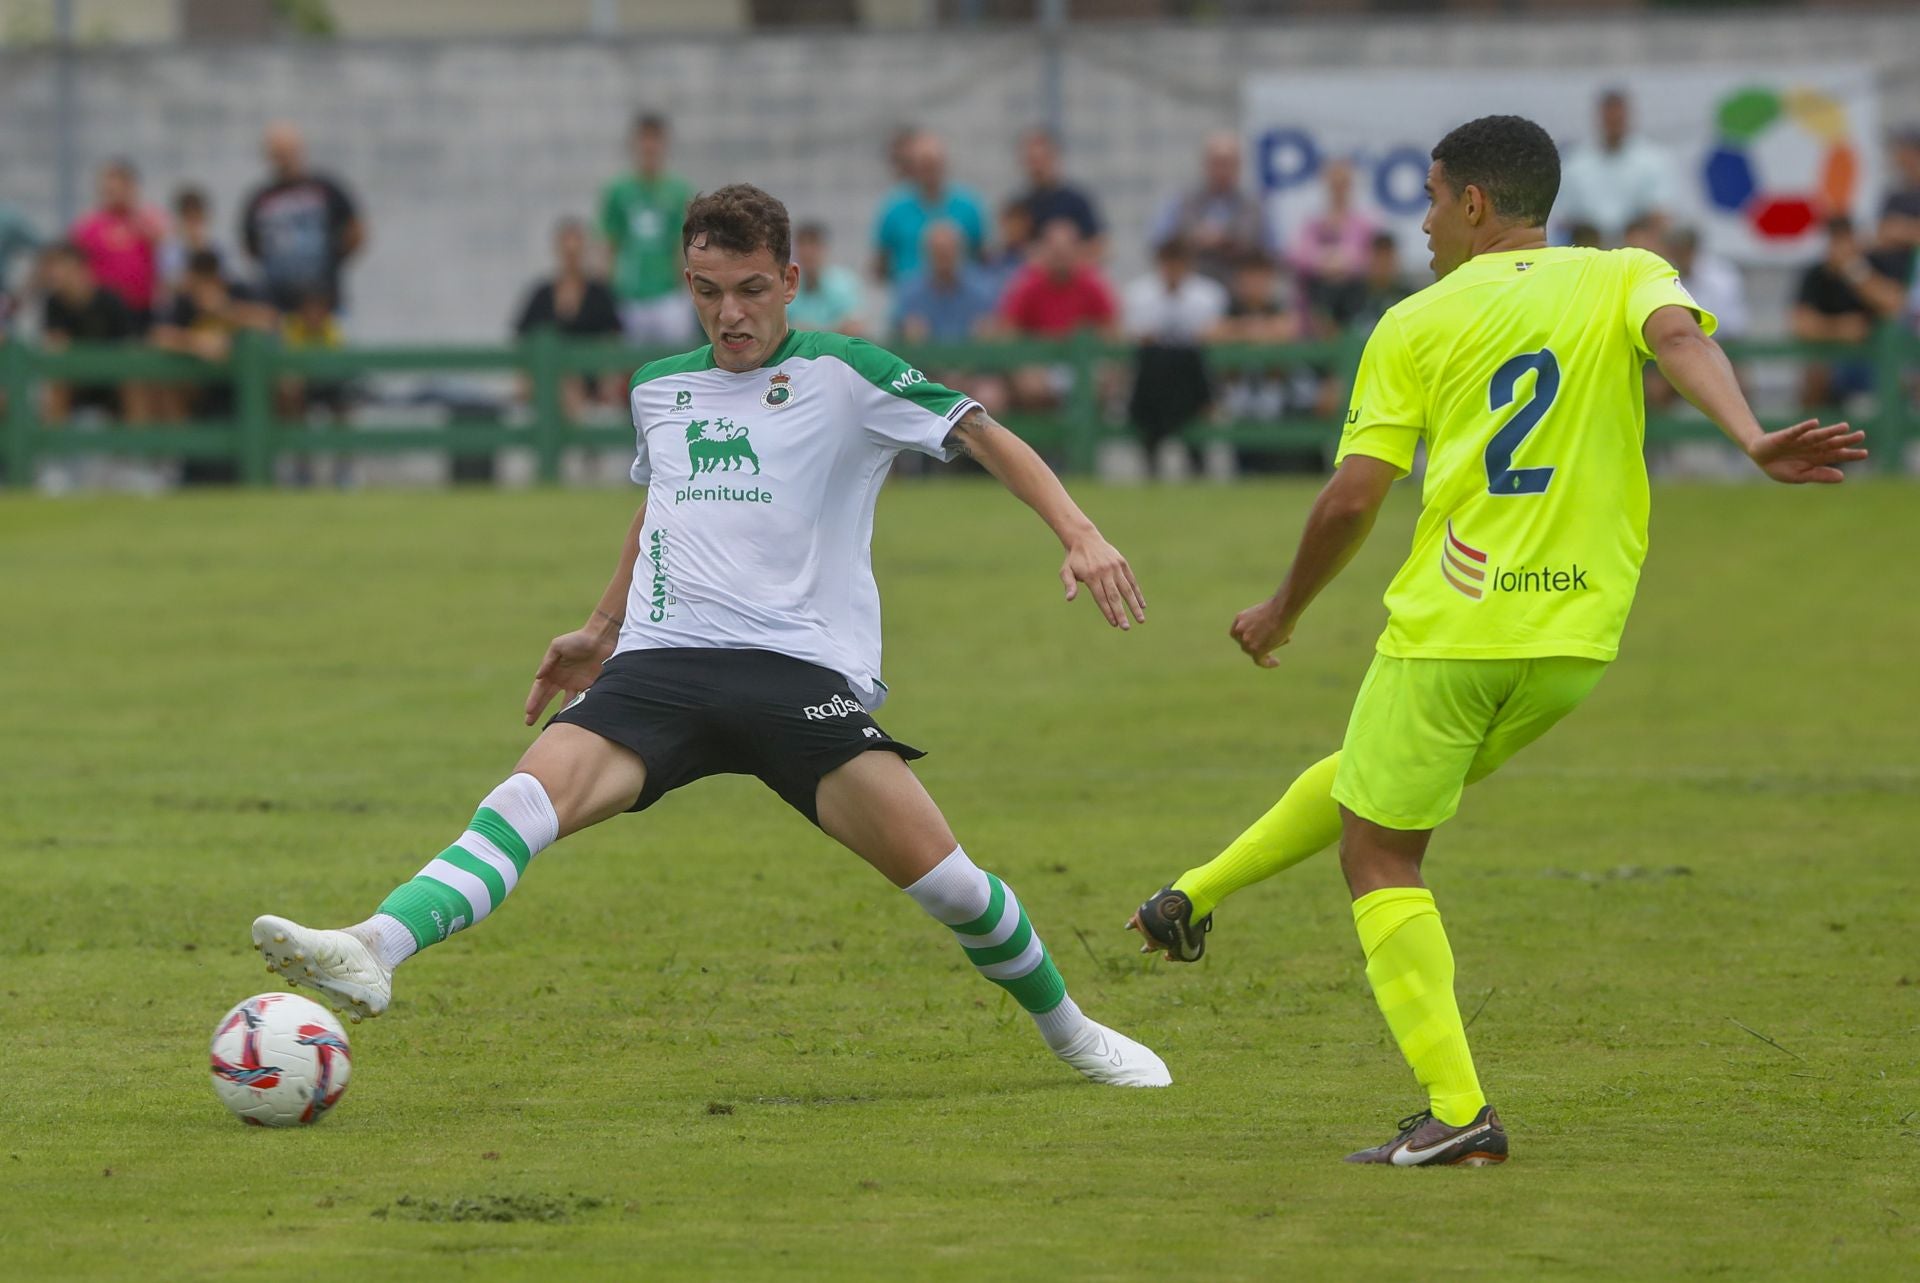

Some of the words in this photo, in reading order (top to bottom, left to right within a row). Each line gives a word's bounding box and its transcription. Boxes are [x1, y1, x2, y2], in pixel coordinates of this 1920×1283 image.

[1485, 347, 1561, 496] 2
[675, 485, 773, 505] plenitude
[1493, 564, 1588, 592] lointek
